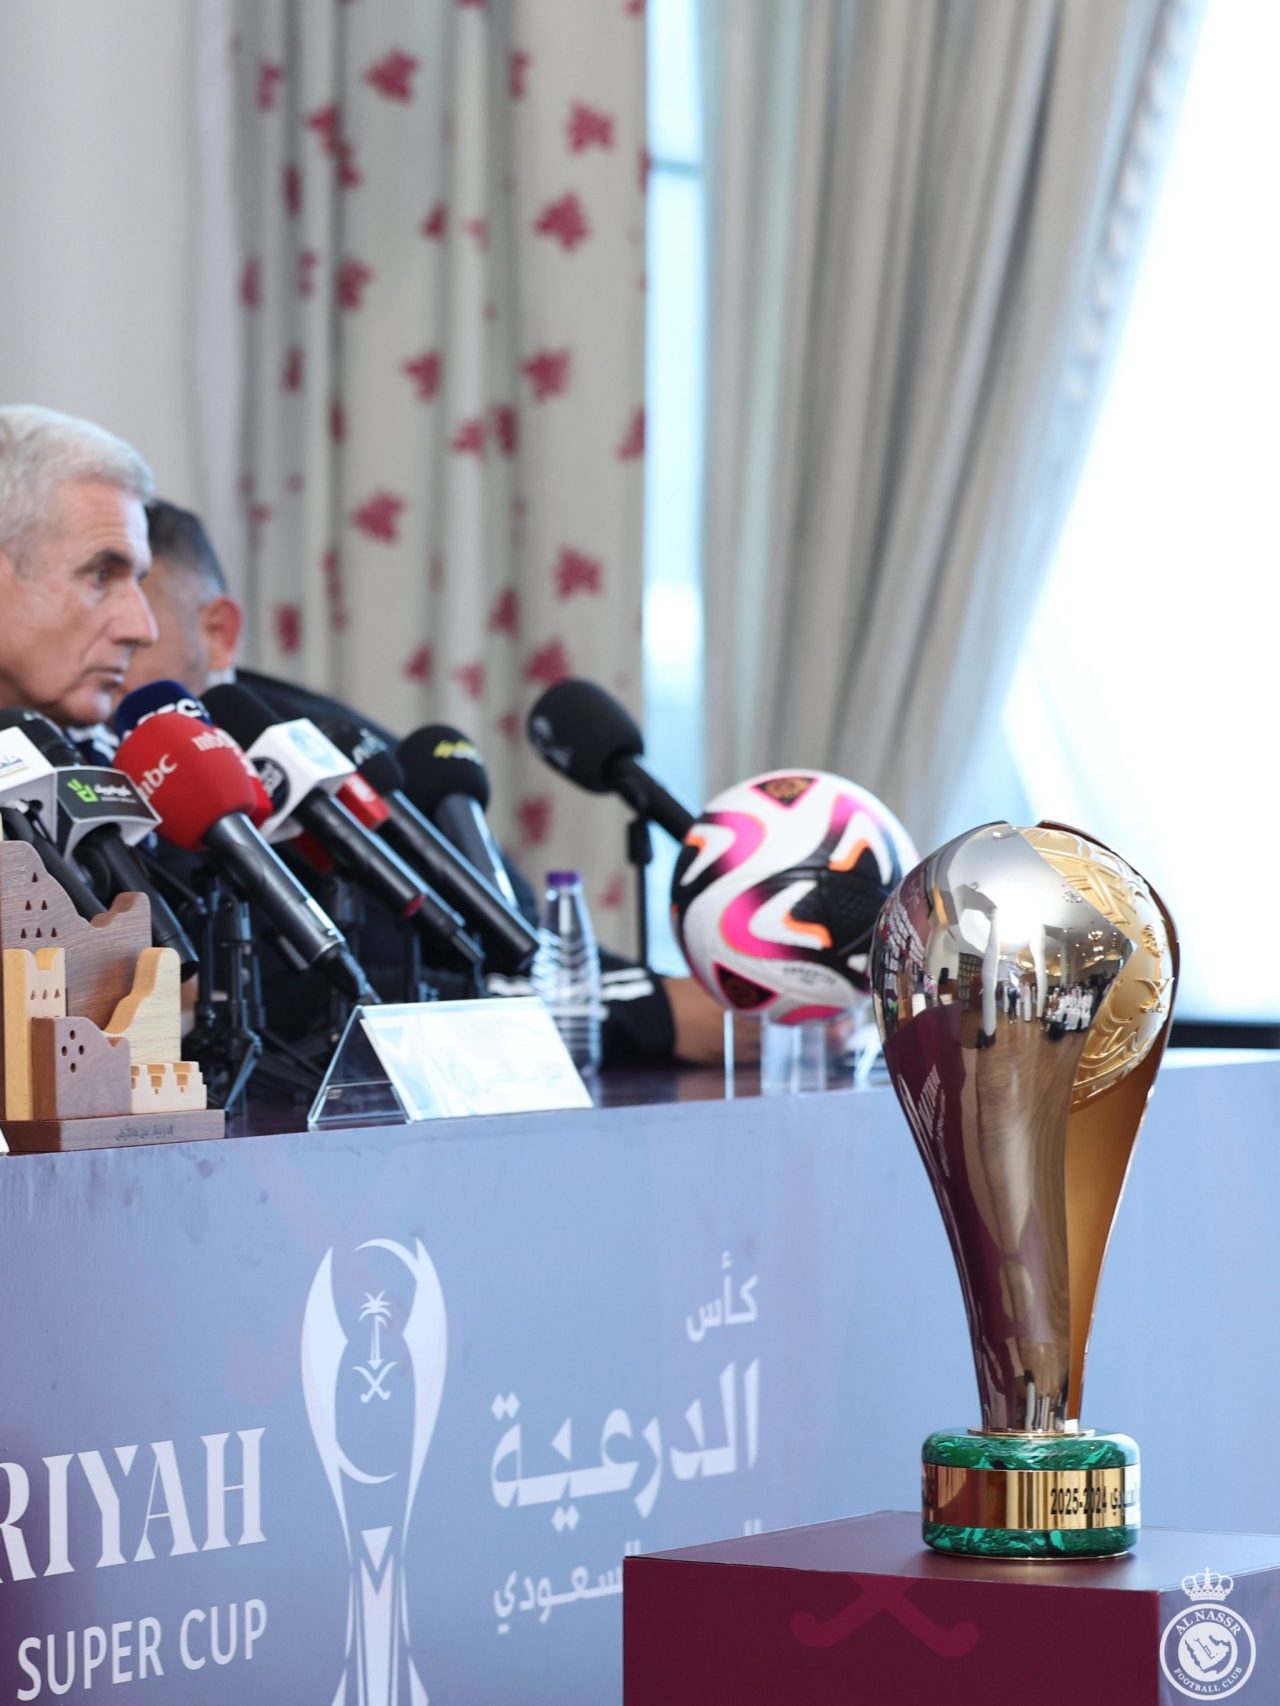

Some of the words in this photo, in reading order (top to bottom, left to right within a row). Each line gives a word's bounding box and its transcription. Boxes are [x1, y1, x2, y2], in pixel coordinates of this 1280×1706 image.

[685, 1252, 759, 1342] كأس
[491, 1358, 760, 1533] الدرعية
[494, 1541, 641, 1634] سعودي
[17, 1616, 165, 1703] SUPER
[179, 1598, 268, 1671] CUP
